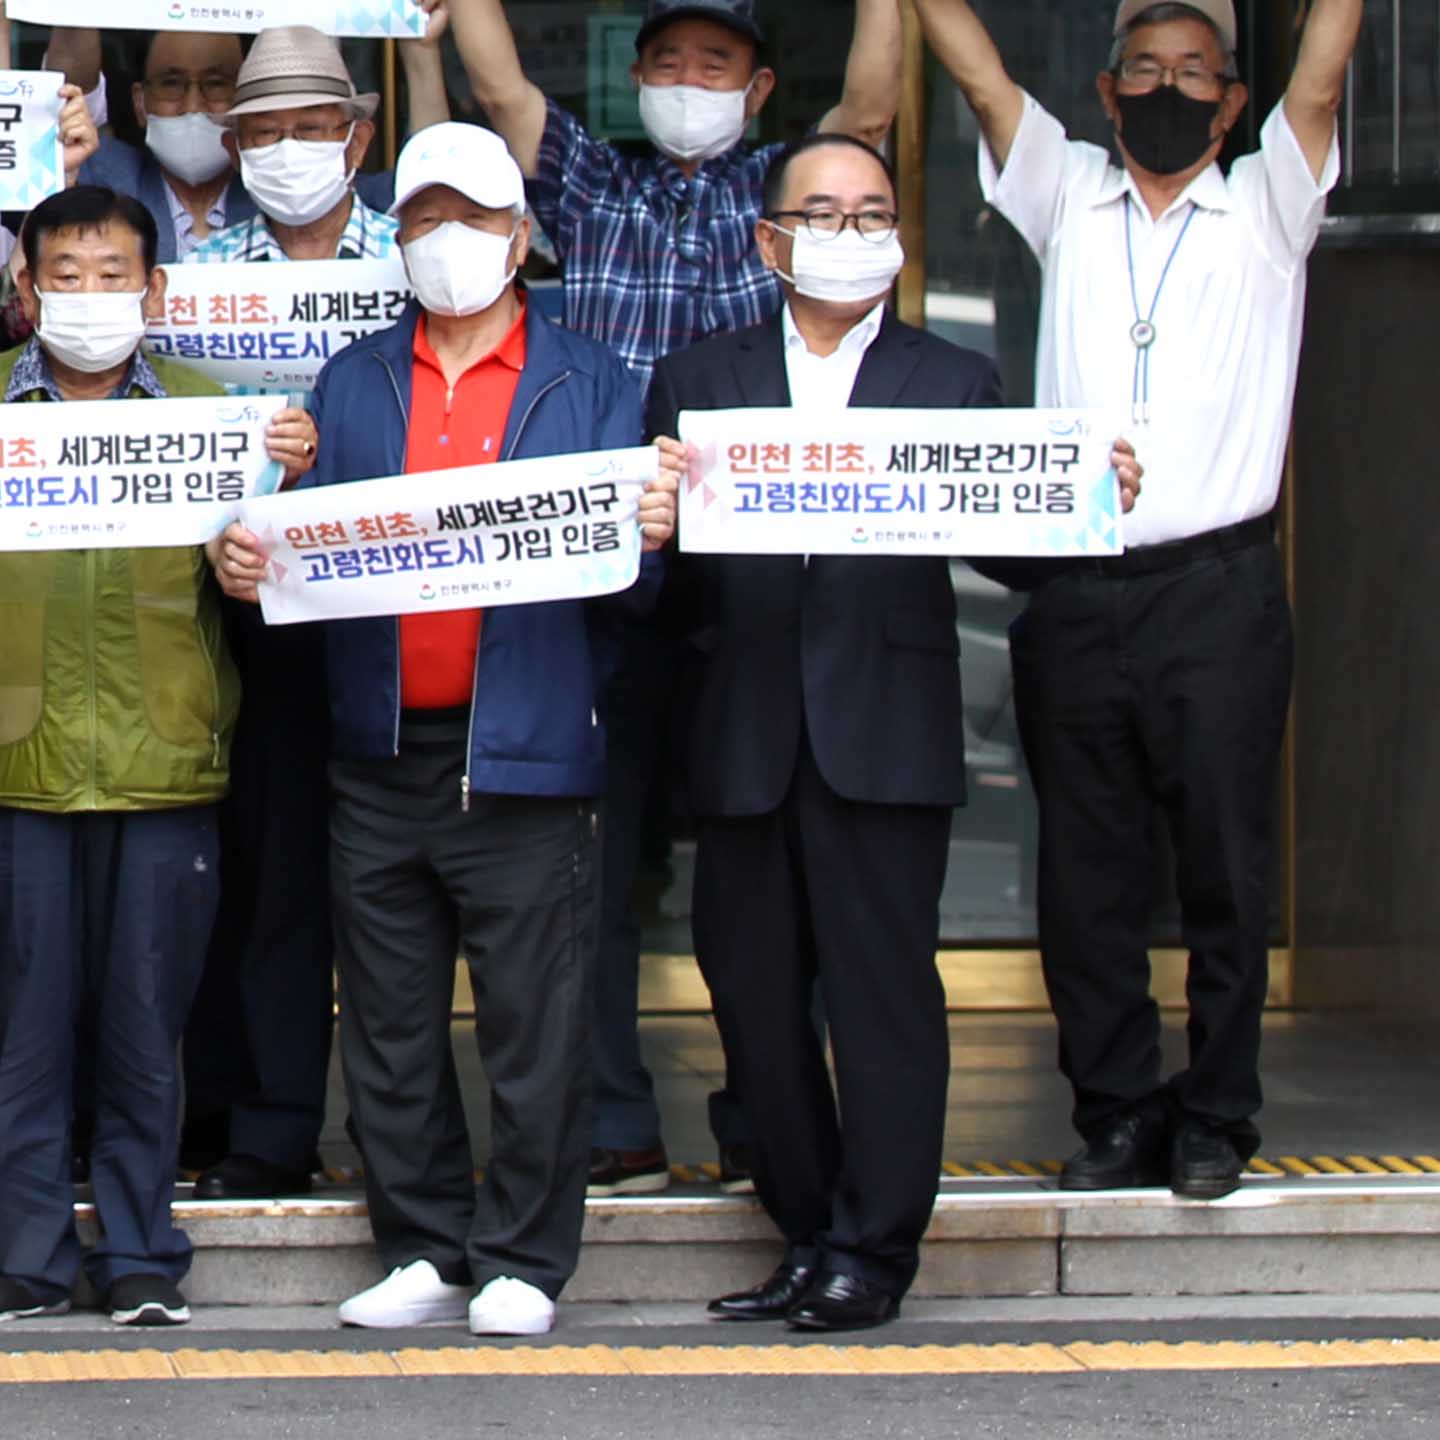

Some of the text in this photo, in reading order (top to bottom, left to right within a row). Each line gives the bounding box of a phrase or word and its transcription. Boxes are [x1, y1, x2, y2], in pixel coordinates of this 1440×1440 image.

[57, 432, 249, 467] 세계보건기구
[728, 443, 1080, 474] 인천 최초, 세계보건기구
[111, 473, 172, 504] 가입
[184, 470, 245, 503] 인증
[734, 482, 1075, 514] 고령친화도시 가입 인증
[285, 482, 620, 550] 인천 최초, 세계보건기구
[300, 521, 620, 582] 고령친화도시 가입 인증
